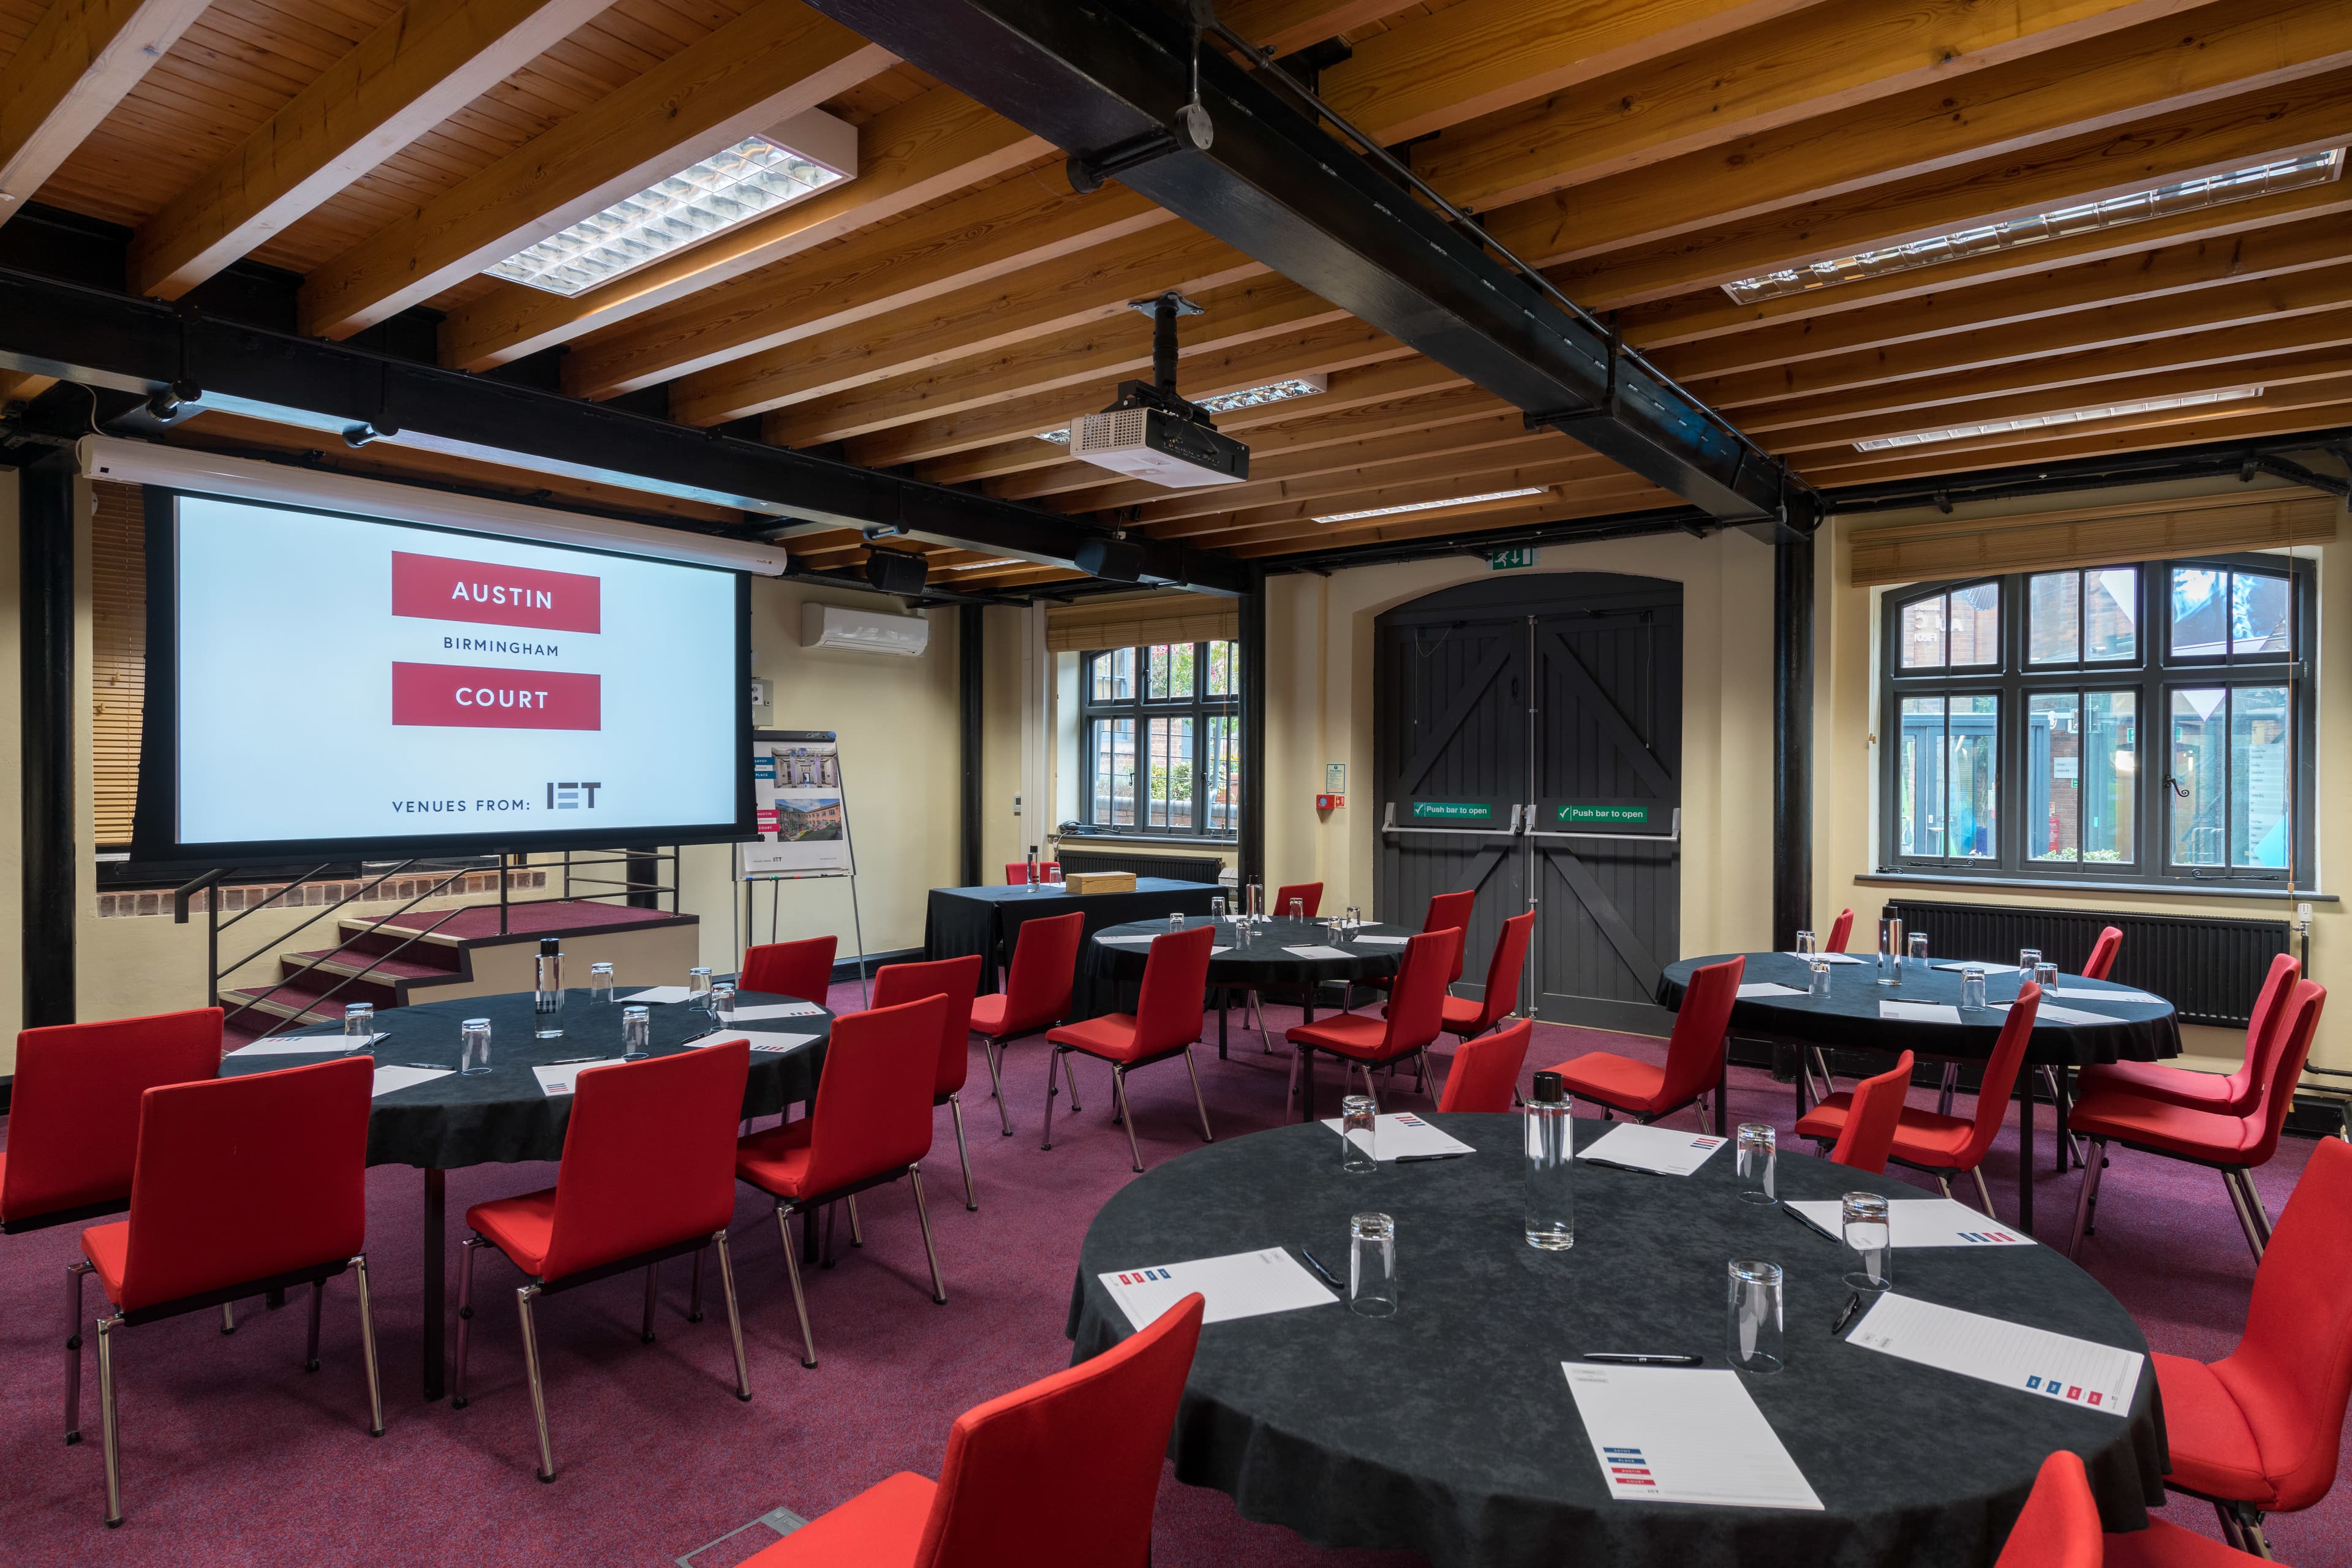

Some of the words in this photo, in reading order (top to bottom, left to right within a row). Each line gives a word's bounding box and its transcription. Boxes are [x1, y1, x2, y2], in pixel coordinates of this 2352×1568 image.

[451, 581, 552, 609] AUSTIN
[443, 636, 559, 657] BIRMINGHAM
[455, 687, 548, 709] COURT
[392, 800, 467, 813] VENUES
[476, 799, 531, 812] FROM:
[546, 782, 601, 810] IET
